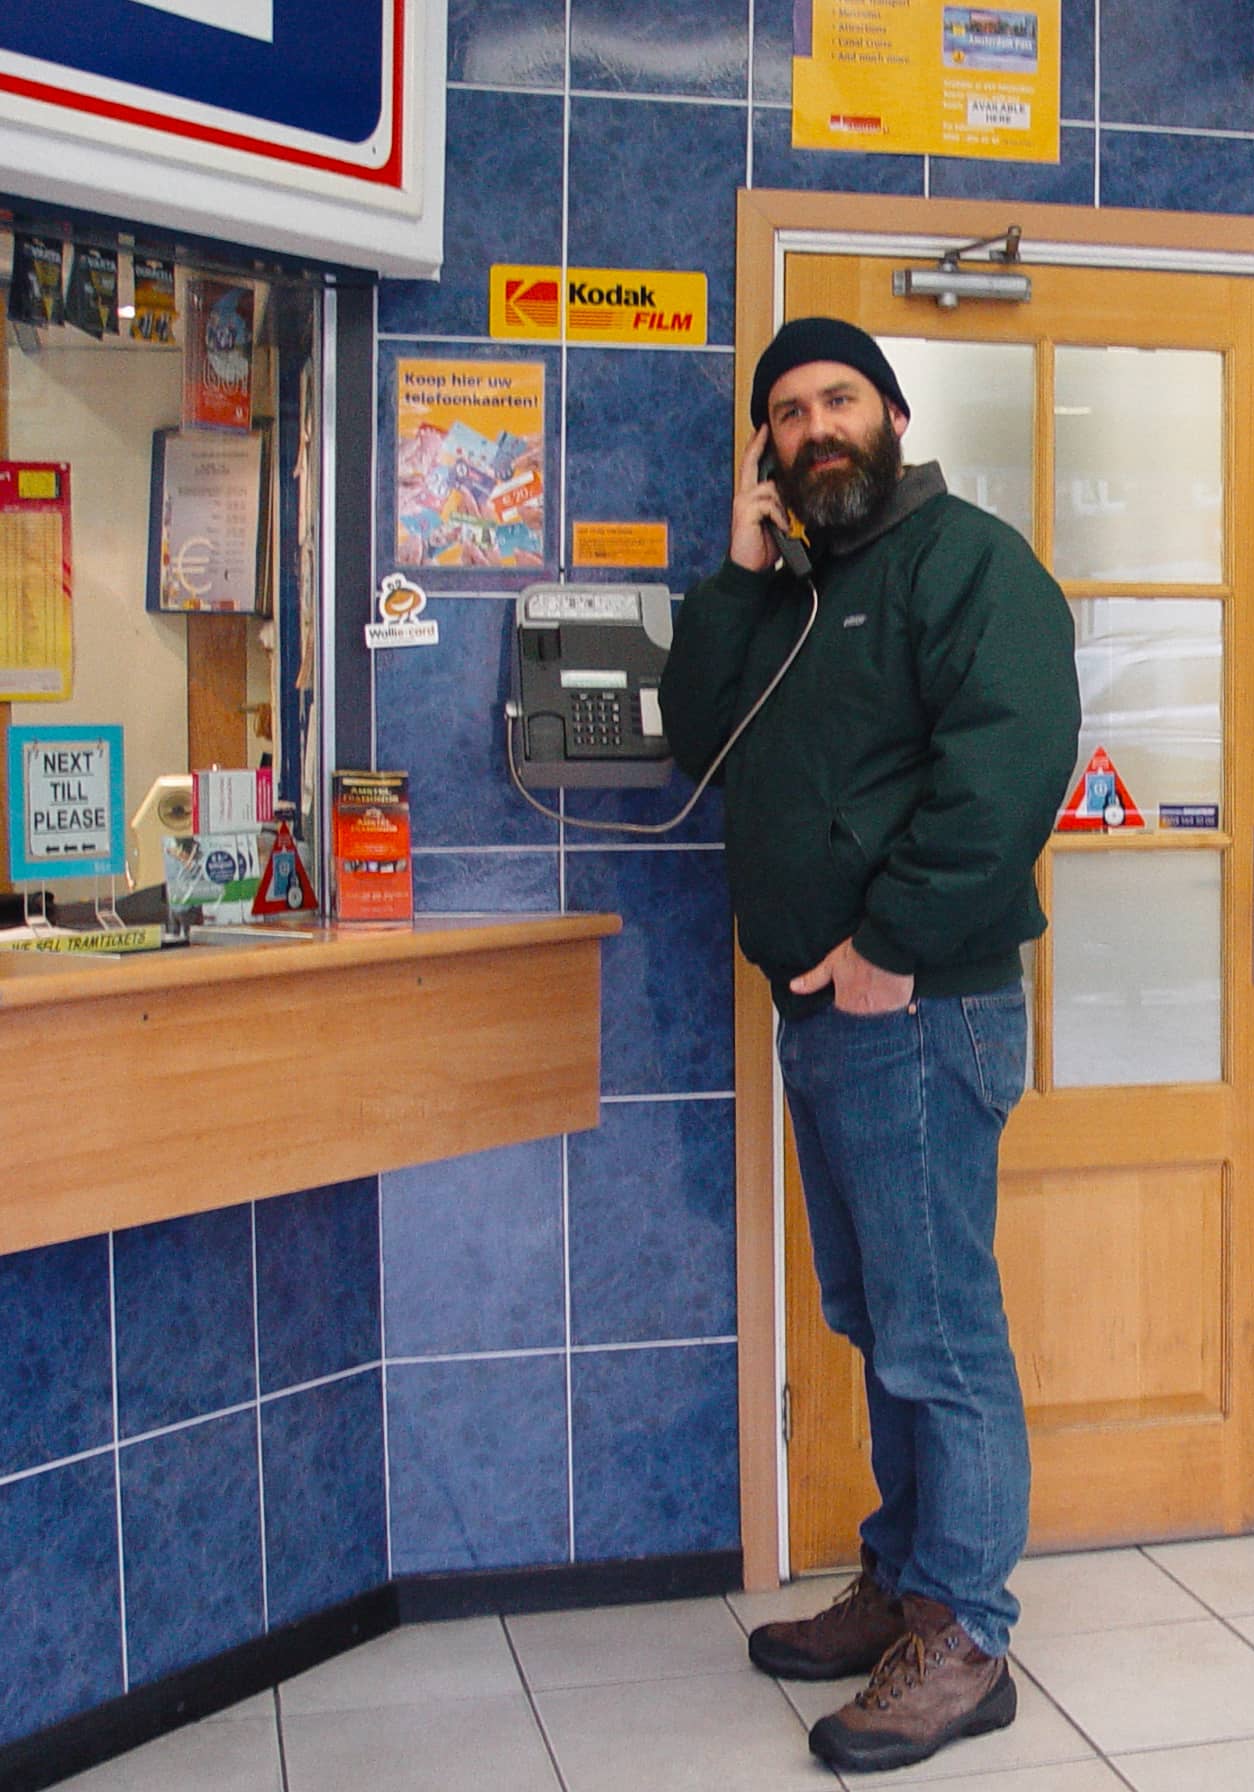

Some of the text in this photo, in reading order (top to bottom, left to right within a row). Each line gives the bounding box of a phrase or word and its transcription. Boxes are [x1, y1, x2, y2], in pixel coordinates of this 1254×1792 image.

[568, 281, 656, 307] Kodak
[632, 311, 693, 333] FILM
[404, 371, 512, 388] Koop hier uw
[403, 393, 539, 409] telefoonkaarten!
[43, 751, 95, 773] NEXT
[50, 781, 89, 801] TILL
[33, 807, 106, 831] PLEASE
[67, 928, 147, 951] TRAMTICKETS
